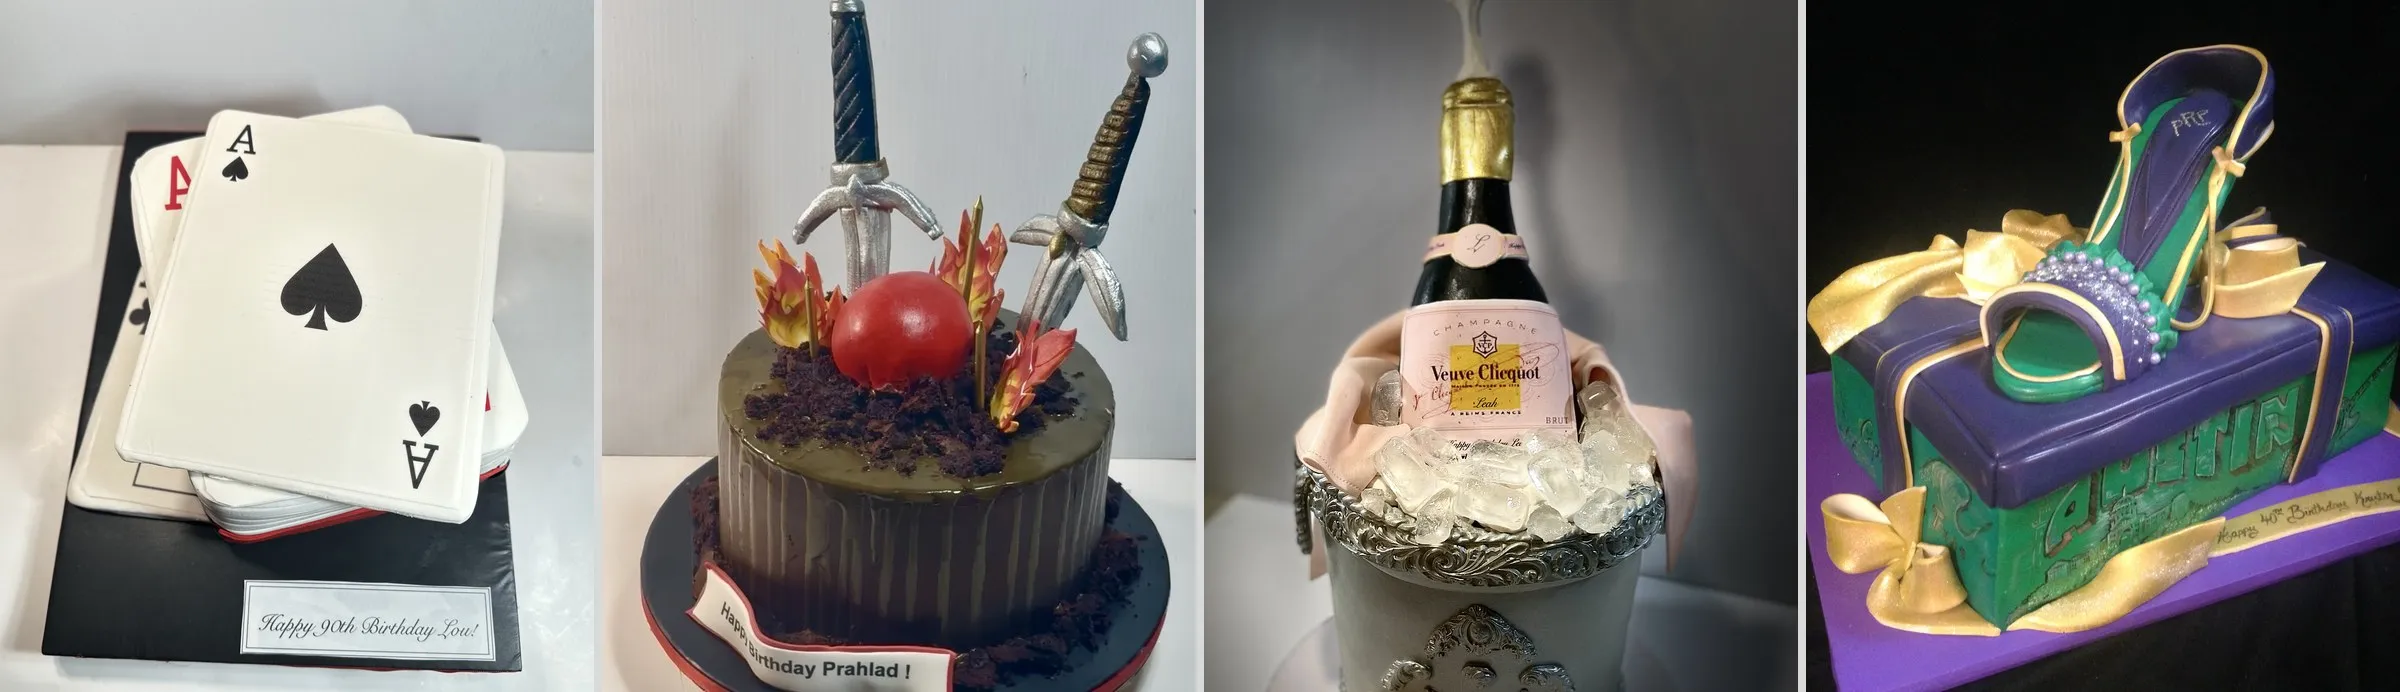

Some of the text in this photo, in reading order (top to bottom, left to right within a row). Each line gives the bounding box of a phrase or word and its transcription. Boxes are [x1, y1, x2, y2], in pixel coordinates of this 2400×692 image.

[227, 124, 256, 155] A
[1433, 319, 1538, 336] CHAMPAGNE
[1431, 363, 1541, 383] Veuve Clicquot
[1473, 396, 1499, 408] Leah
[1545, 416, 1569, 425] BRUT
[402, 439, 439, 489] A
[2217, 525, 2259, 544] Happy
[2286, 500, 2349, 524] Birthday
[258, 614, 479, 642] Happy 90th Birthday Lou!
[748, 641, 816, 679] Birthday
[822, 661, 899, 679] Prahlad
